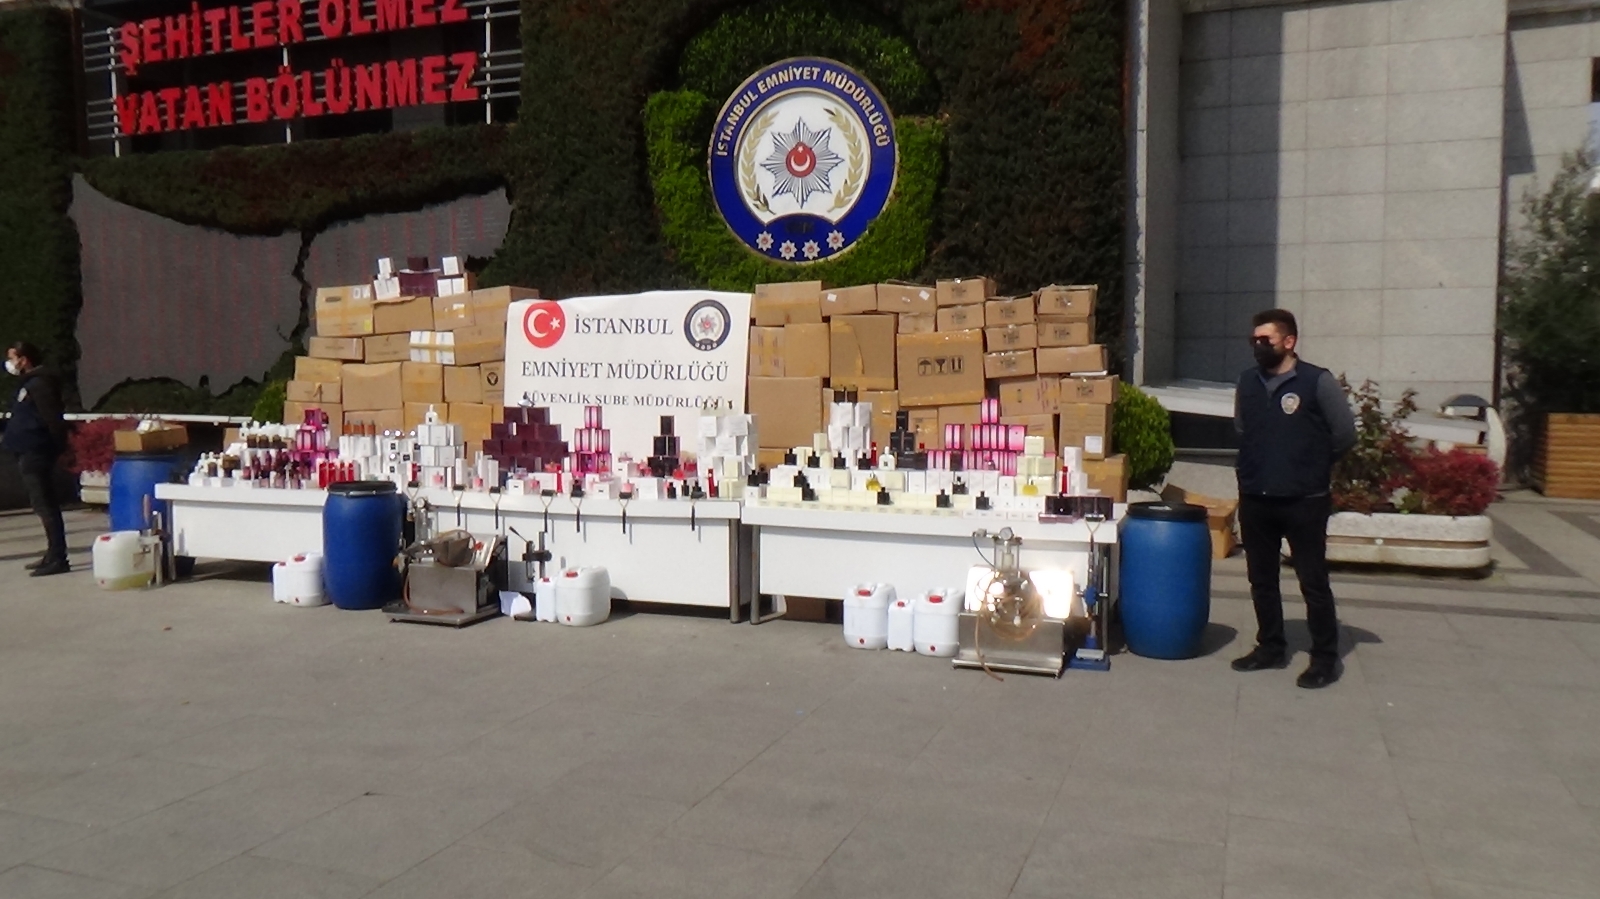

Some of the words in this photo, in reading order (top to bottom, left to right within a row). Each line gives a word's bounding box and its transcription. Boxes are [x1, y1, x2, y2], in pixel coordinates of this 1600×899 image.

[119, 1, 304, 75] ŞEHİTLER
[115, 81, 233, 135] VATAN
[246, 52, 479, 123] BÖLÜNMEZ
[716, 90, 759, 157] İSTANBUL
[758, 65, 821, 93] EMNİYET
[822, 69, 891, 147] MÜDÜRLÜĞÜ
[574, 313, 674, 335] İSTANBUL
[521, 357, 603, 379] EMNİYET
[606, 359, 730, 382] MÜDÜRLÜĞÜ
